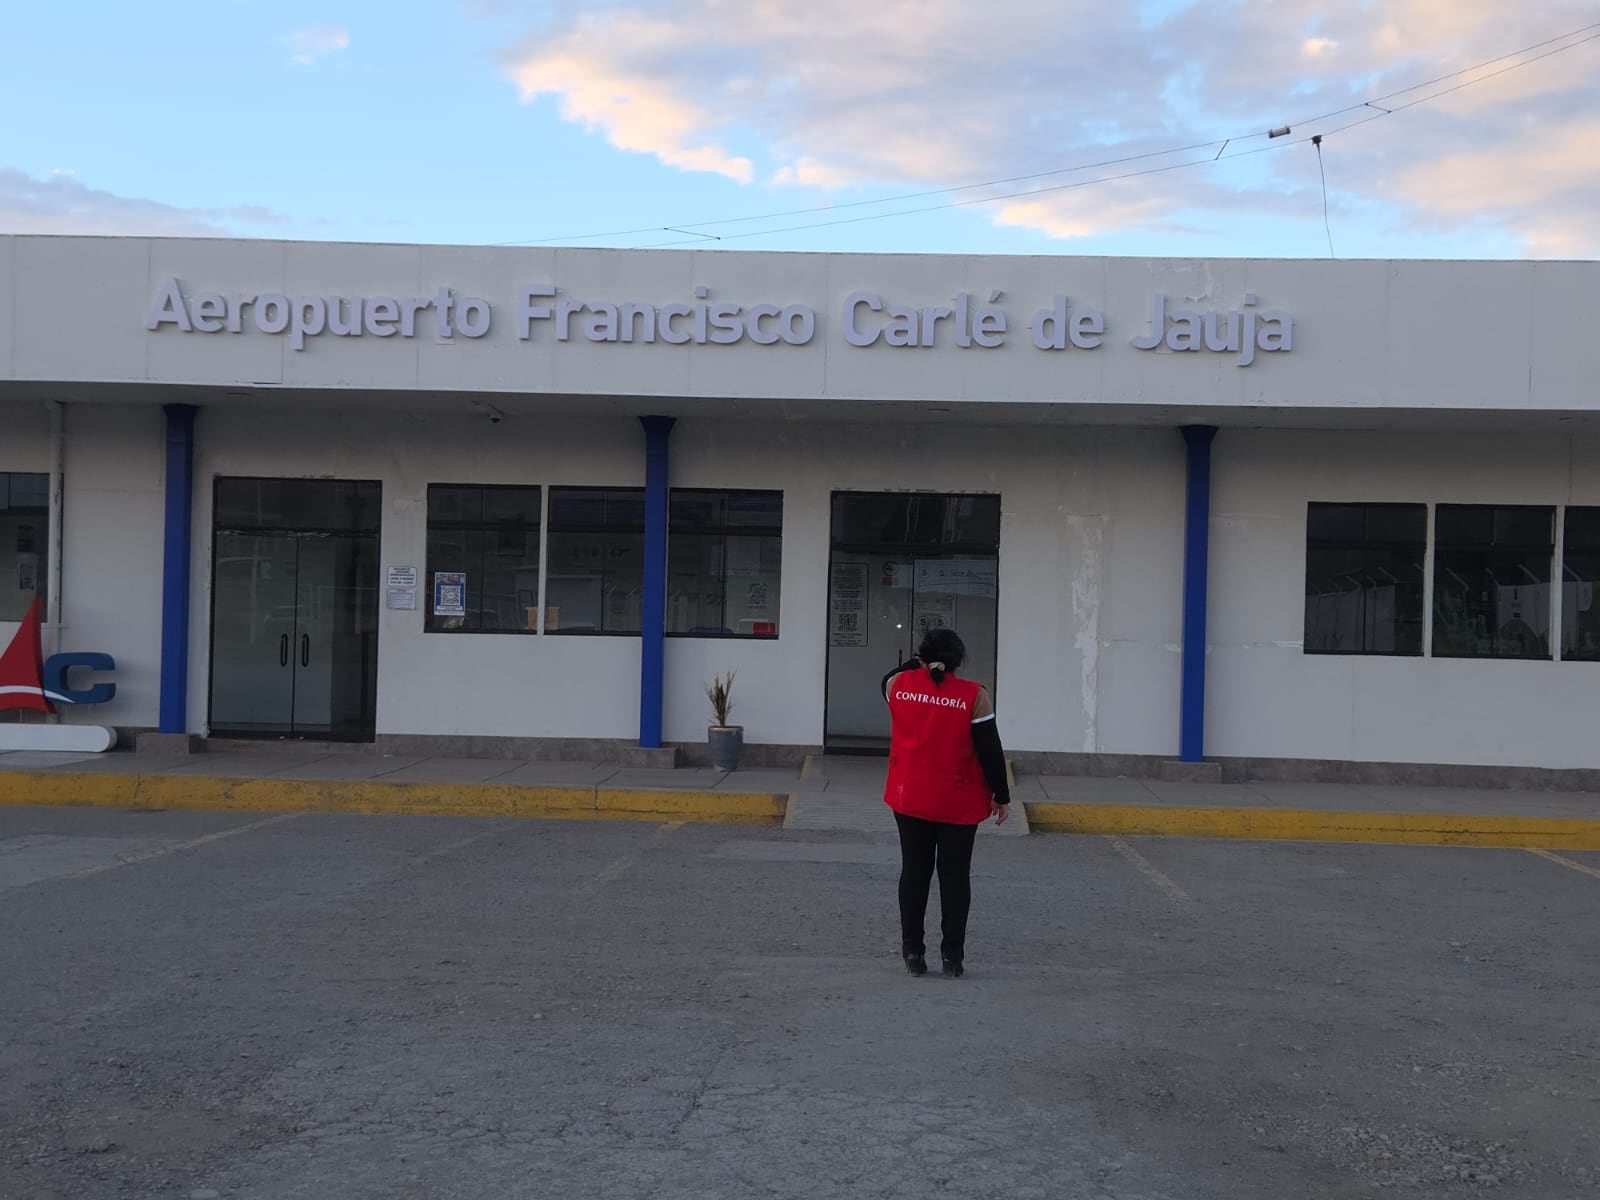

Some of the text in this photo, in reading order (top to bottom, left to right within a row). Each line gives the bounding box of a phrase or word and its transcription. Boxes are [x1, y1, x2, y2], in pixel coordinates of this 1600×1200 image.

[146, 275, 1294, 367] Aeropuerto Francisco Carlé de Jauja
[896, 691, 967, 710] CONTRALORÍA
